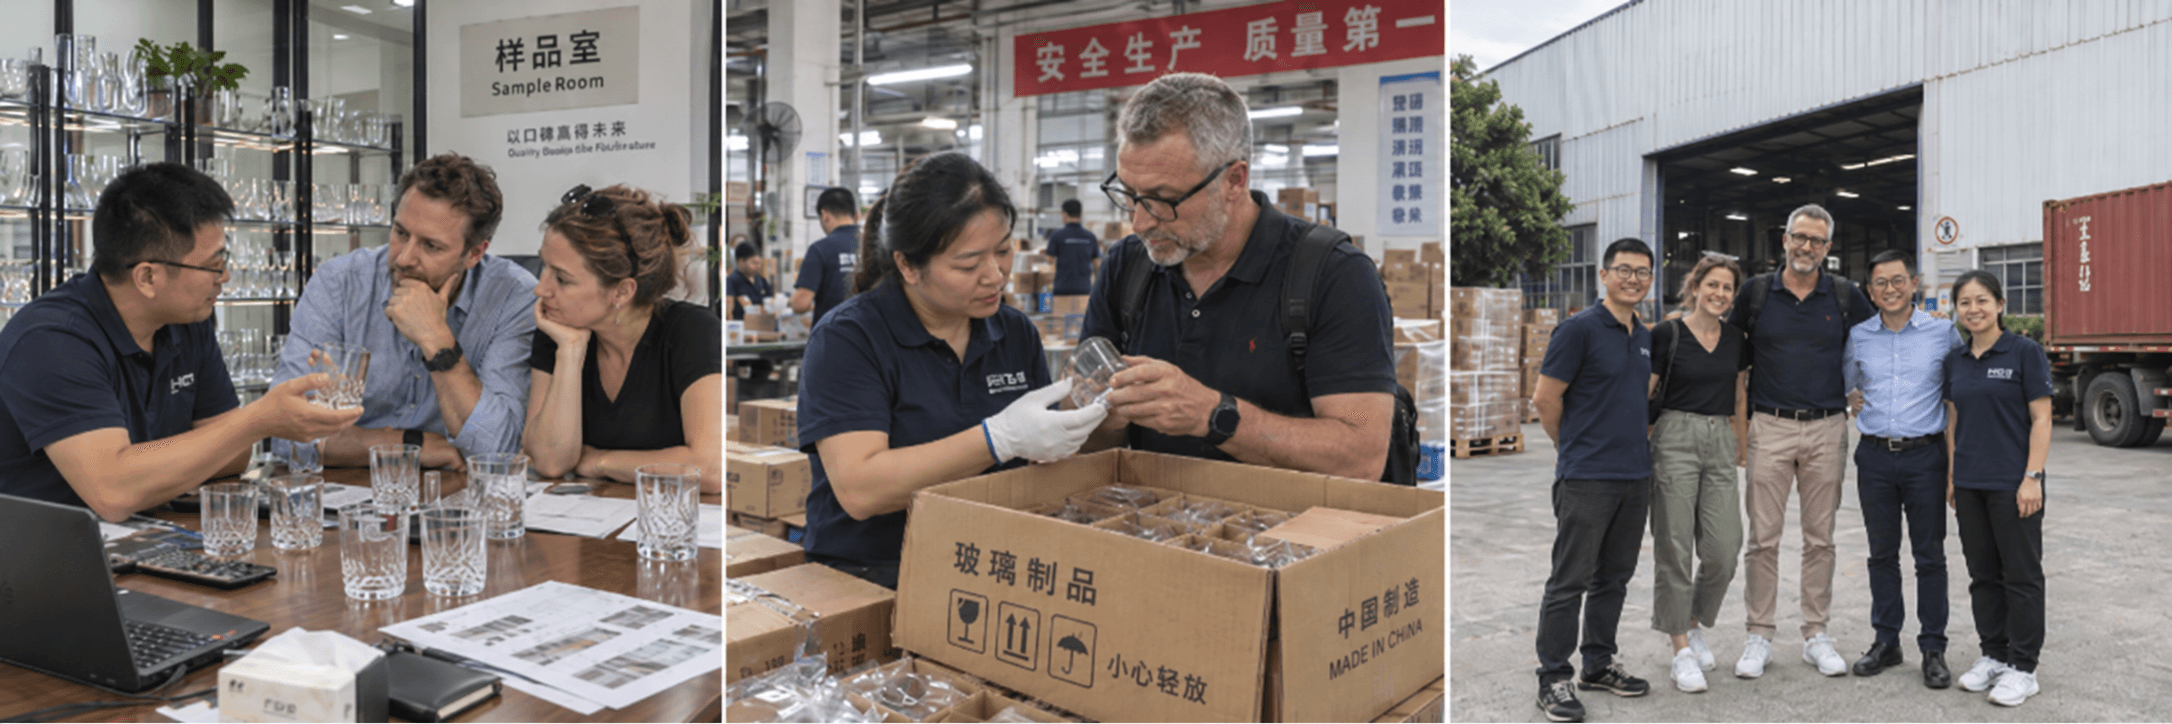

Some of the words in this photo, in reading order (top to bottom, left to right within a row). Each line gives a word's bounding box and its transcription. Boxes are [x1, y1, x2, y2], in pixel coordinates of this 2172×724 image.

[495, 29, 601, 73] 样品室
[1036, 25, 1202, 83] 安全生产
[1243, 4, 1436, 62] 质量第一
[491, 78, 551, 97] Sample
[555, 76, 604, 91] Room
[953, 541, 1097, 607] 玻璃制品
[1338, 576, 1420, 640] 中国制造
[1107, 653, 1208, 705] 小心轻放
[1329, 644, 1369, 681] MADE
[1372, 636, 1385, 659] IN
[1388, 617, 1423, 649] CHINA
